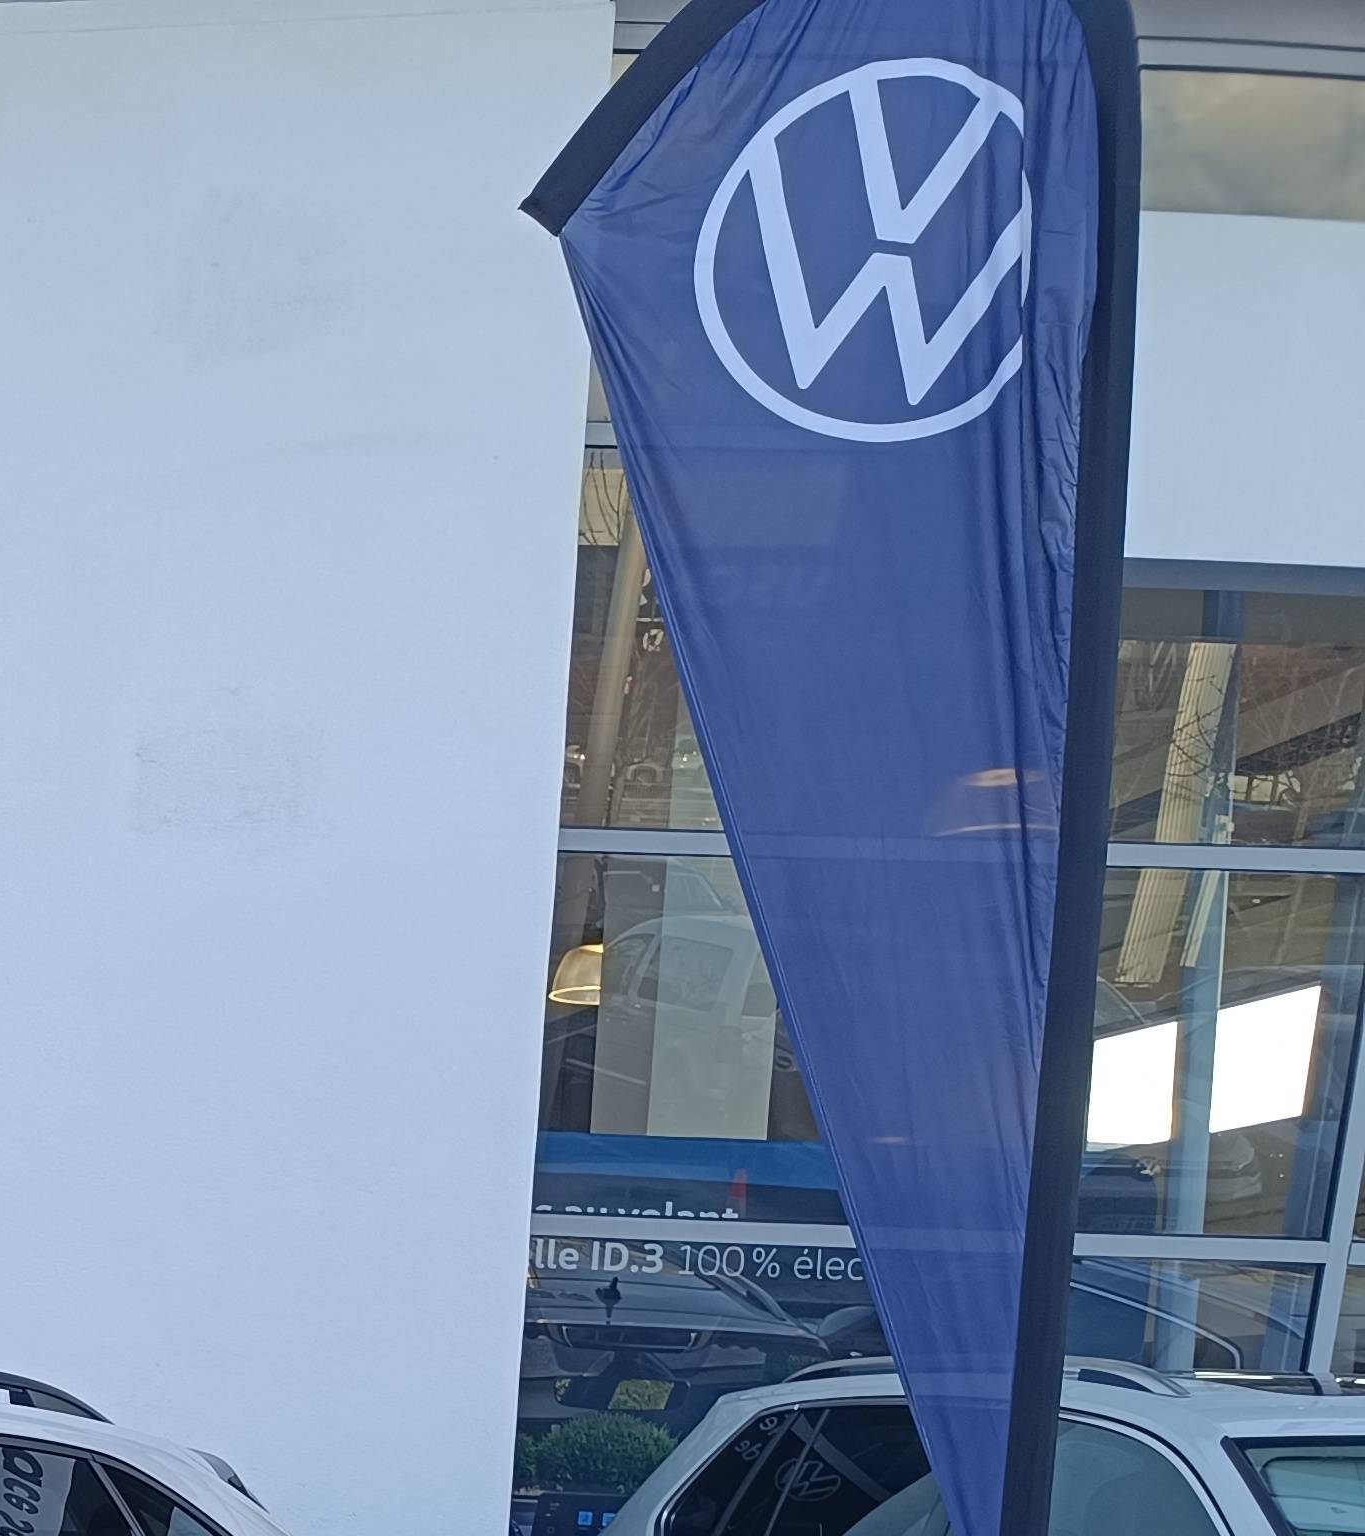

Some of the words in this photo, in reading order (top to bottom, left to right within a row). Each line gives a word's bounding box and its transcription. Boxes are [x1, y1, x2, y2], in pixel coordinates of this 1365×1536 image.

[531, 1238, 580, 1270] lle
[591, 1241, 664, 1274] ID.3
[794, 1248, 866, 1281] élec
